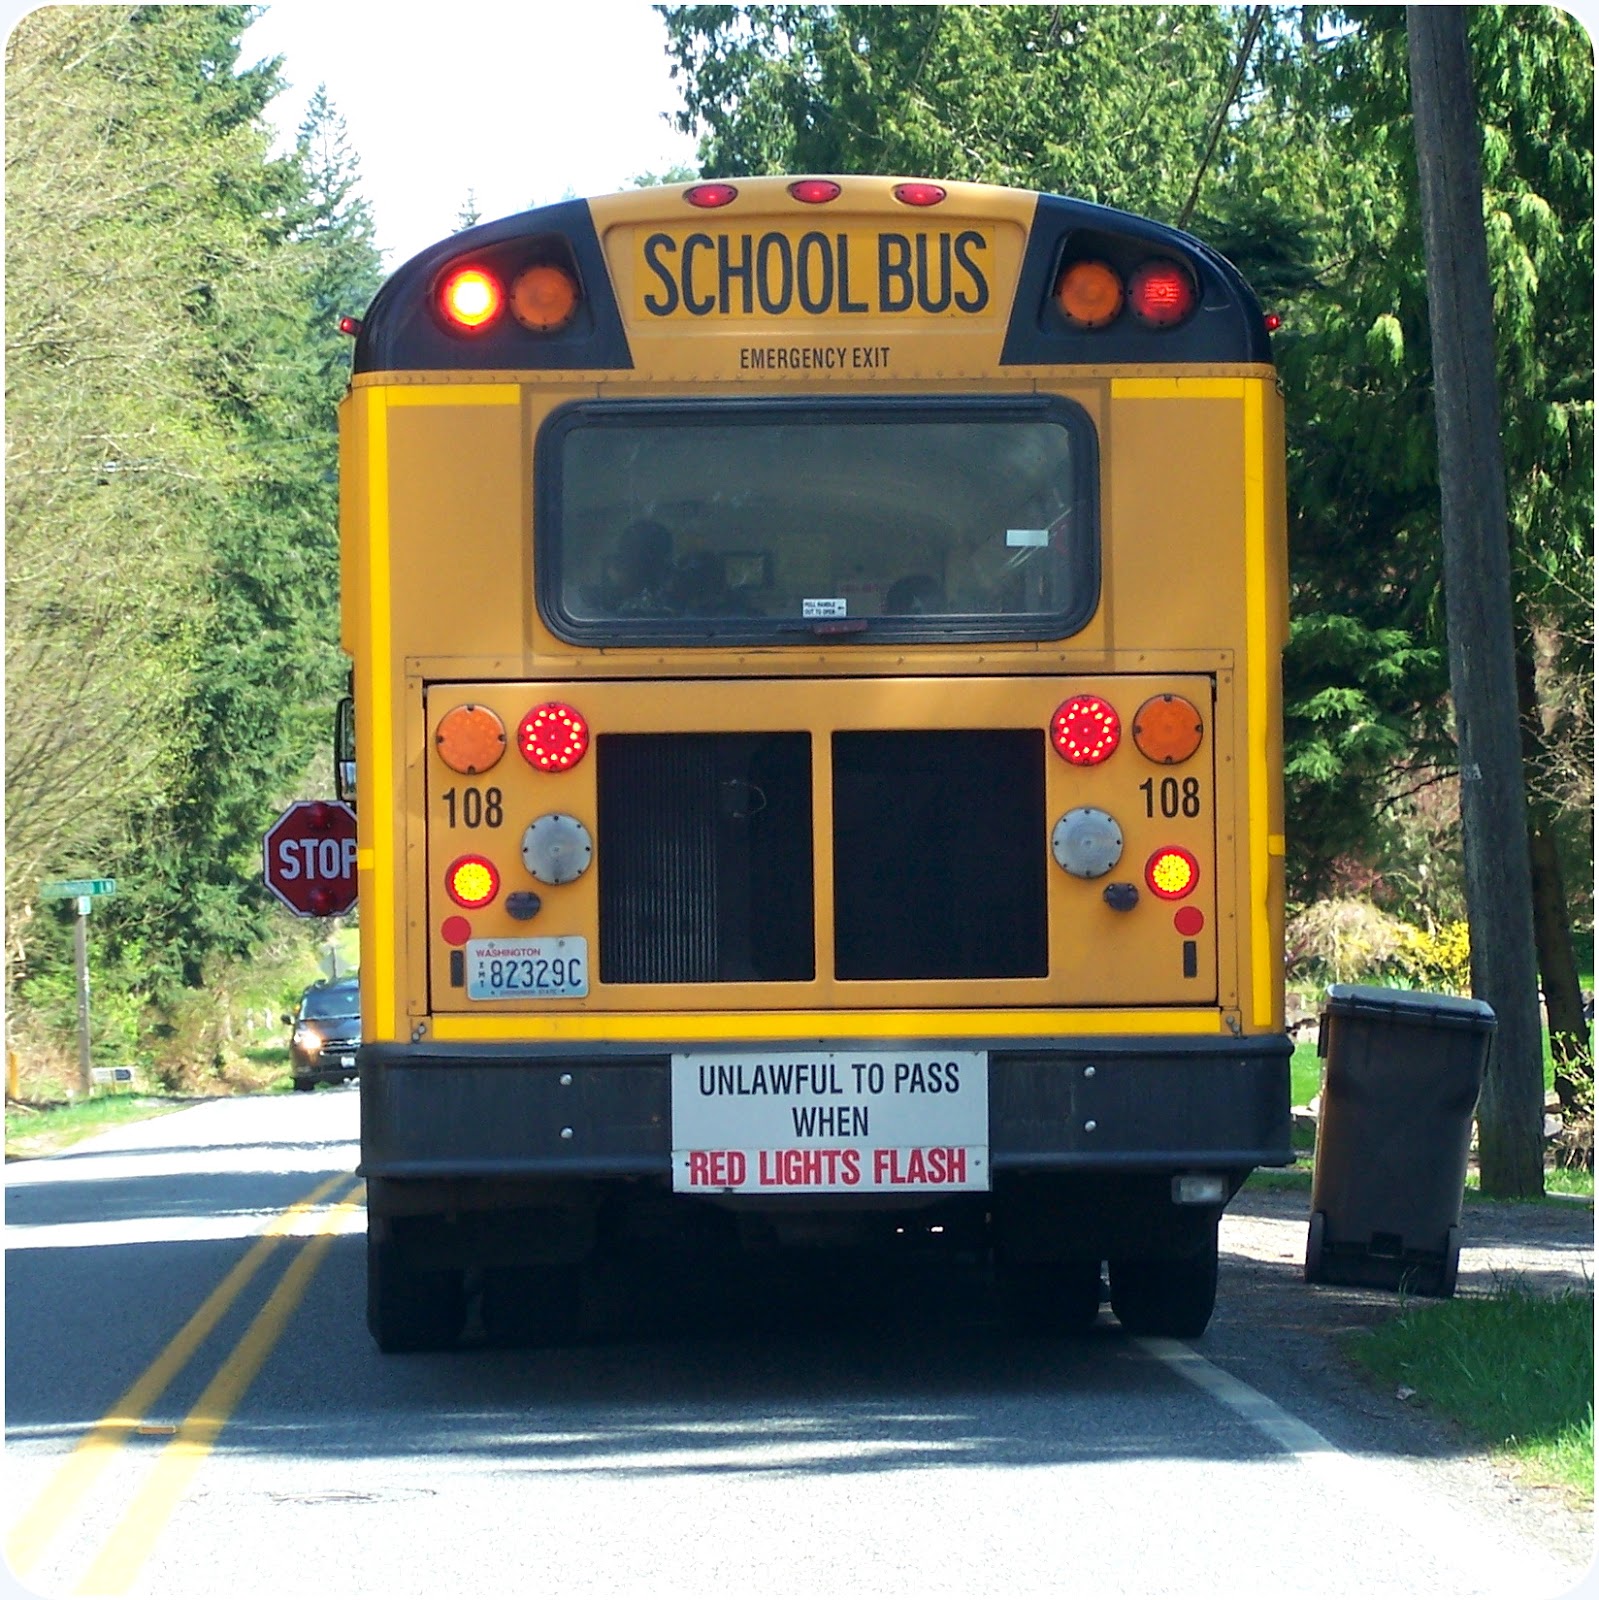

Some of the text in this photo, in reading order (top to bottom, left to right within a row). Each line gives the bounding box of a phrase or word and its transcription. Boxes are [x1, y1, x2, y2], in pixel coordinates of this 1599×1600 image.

[643, 230, 990, 317] SCHOOL BUS
[740, 347, 891, 370] EMERGENCY EXIT
[442, 787, 503, 828] 108
[1139, 777, 1200, 818] 108
[279, 838, 358, 879] STOP
[476, 947, 541, 958] WASHINGTON
[490, 958, 582, 988] 82329C
[700, 1062, 960, 1096] UNLAWFUL TO PASS
[792, 1106, 868, 1137] WHEN
[689, 1148, 966, 1186] RED LIGHTS FLASH
